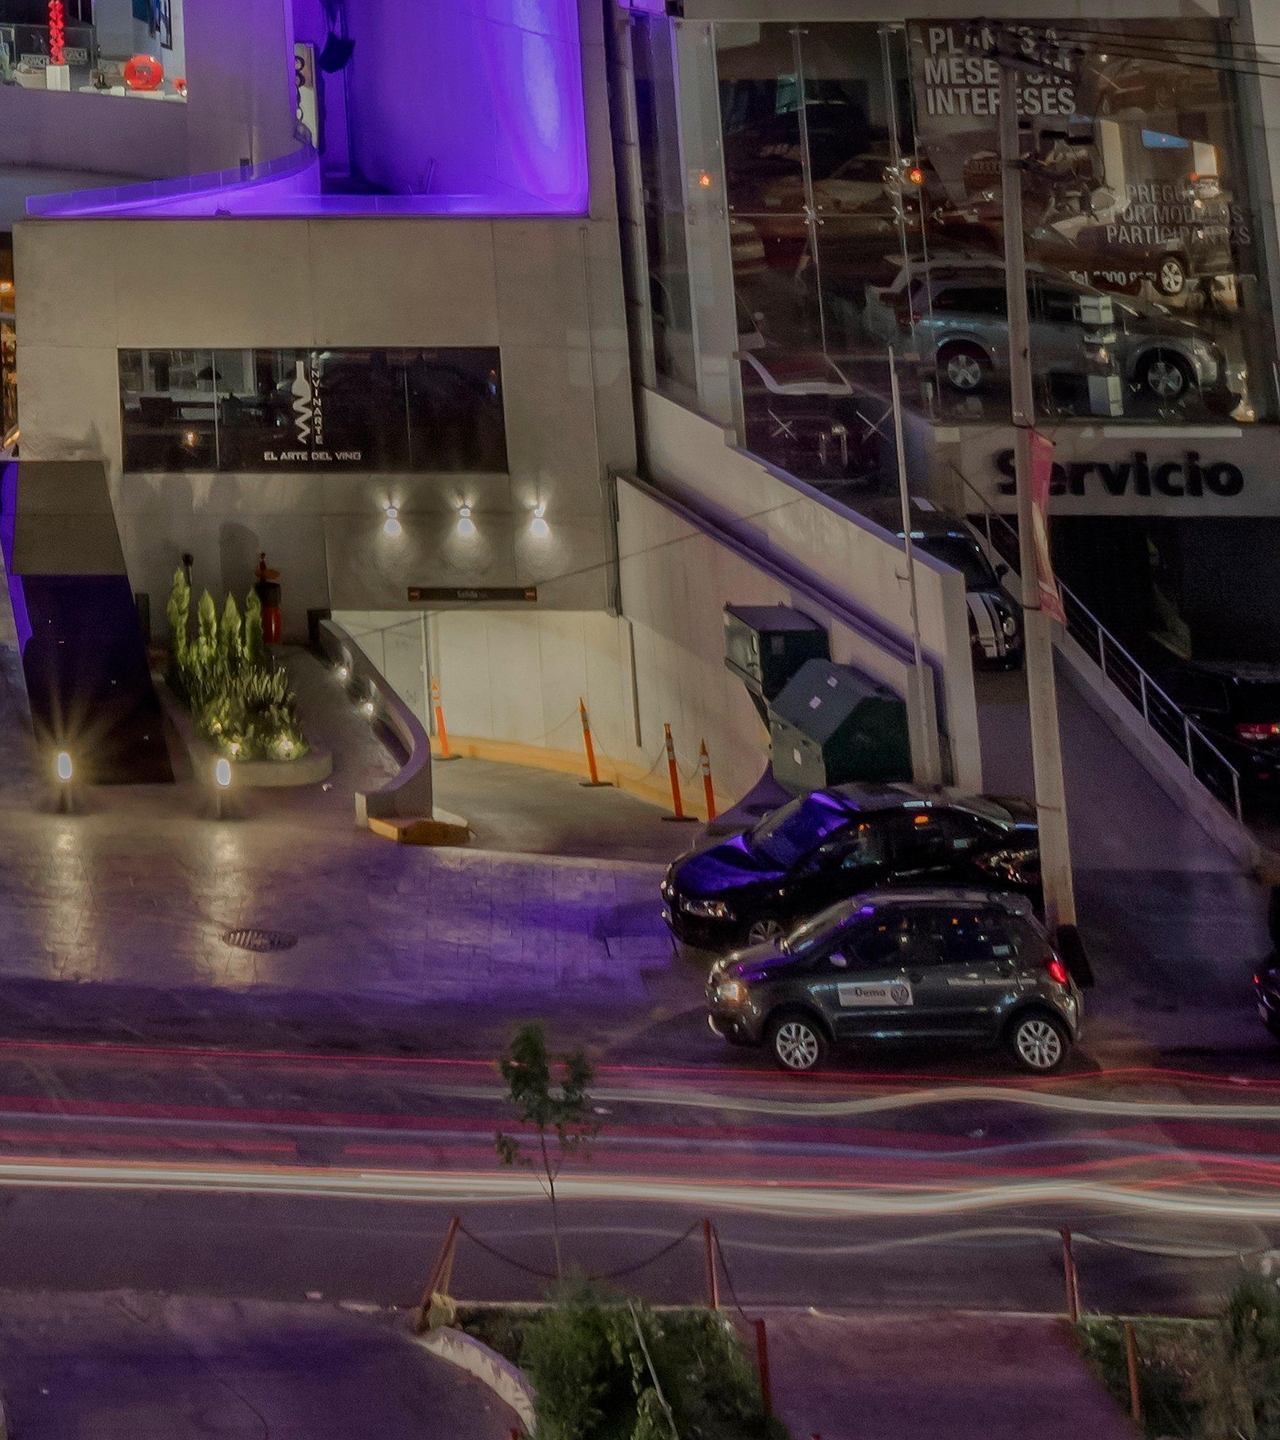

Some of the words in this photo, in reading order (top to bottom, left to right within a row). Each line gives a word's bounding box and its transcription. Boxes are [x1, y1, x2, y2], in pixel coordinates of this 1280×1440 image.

[264, 451, 278, 461] EL
[280, 451, 308, 461] ARTE
[311, 451, 333, 461] DEL
[335, 451, 362, 461] VINO
